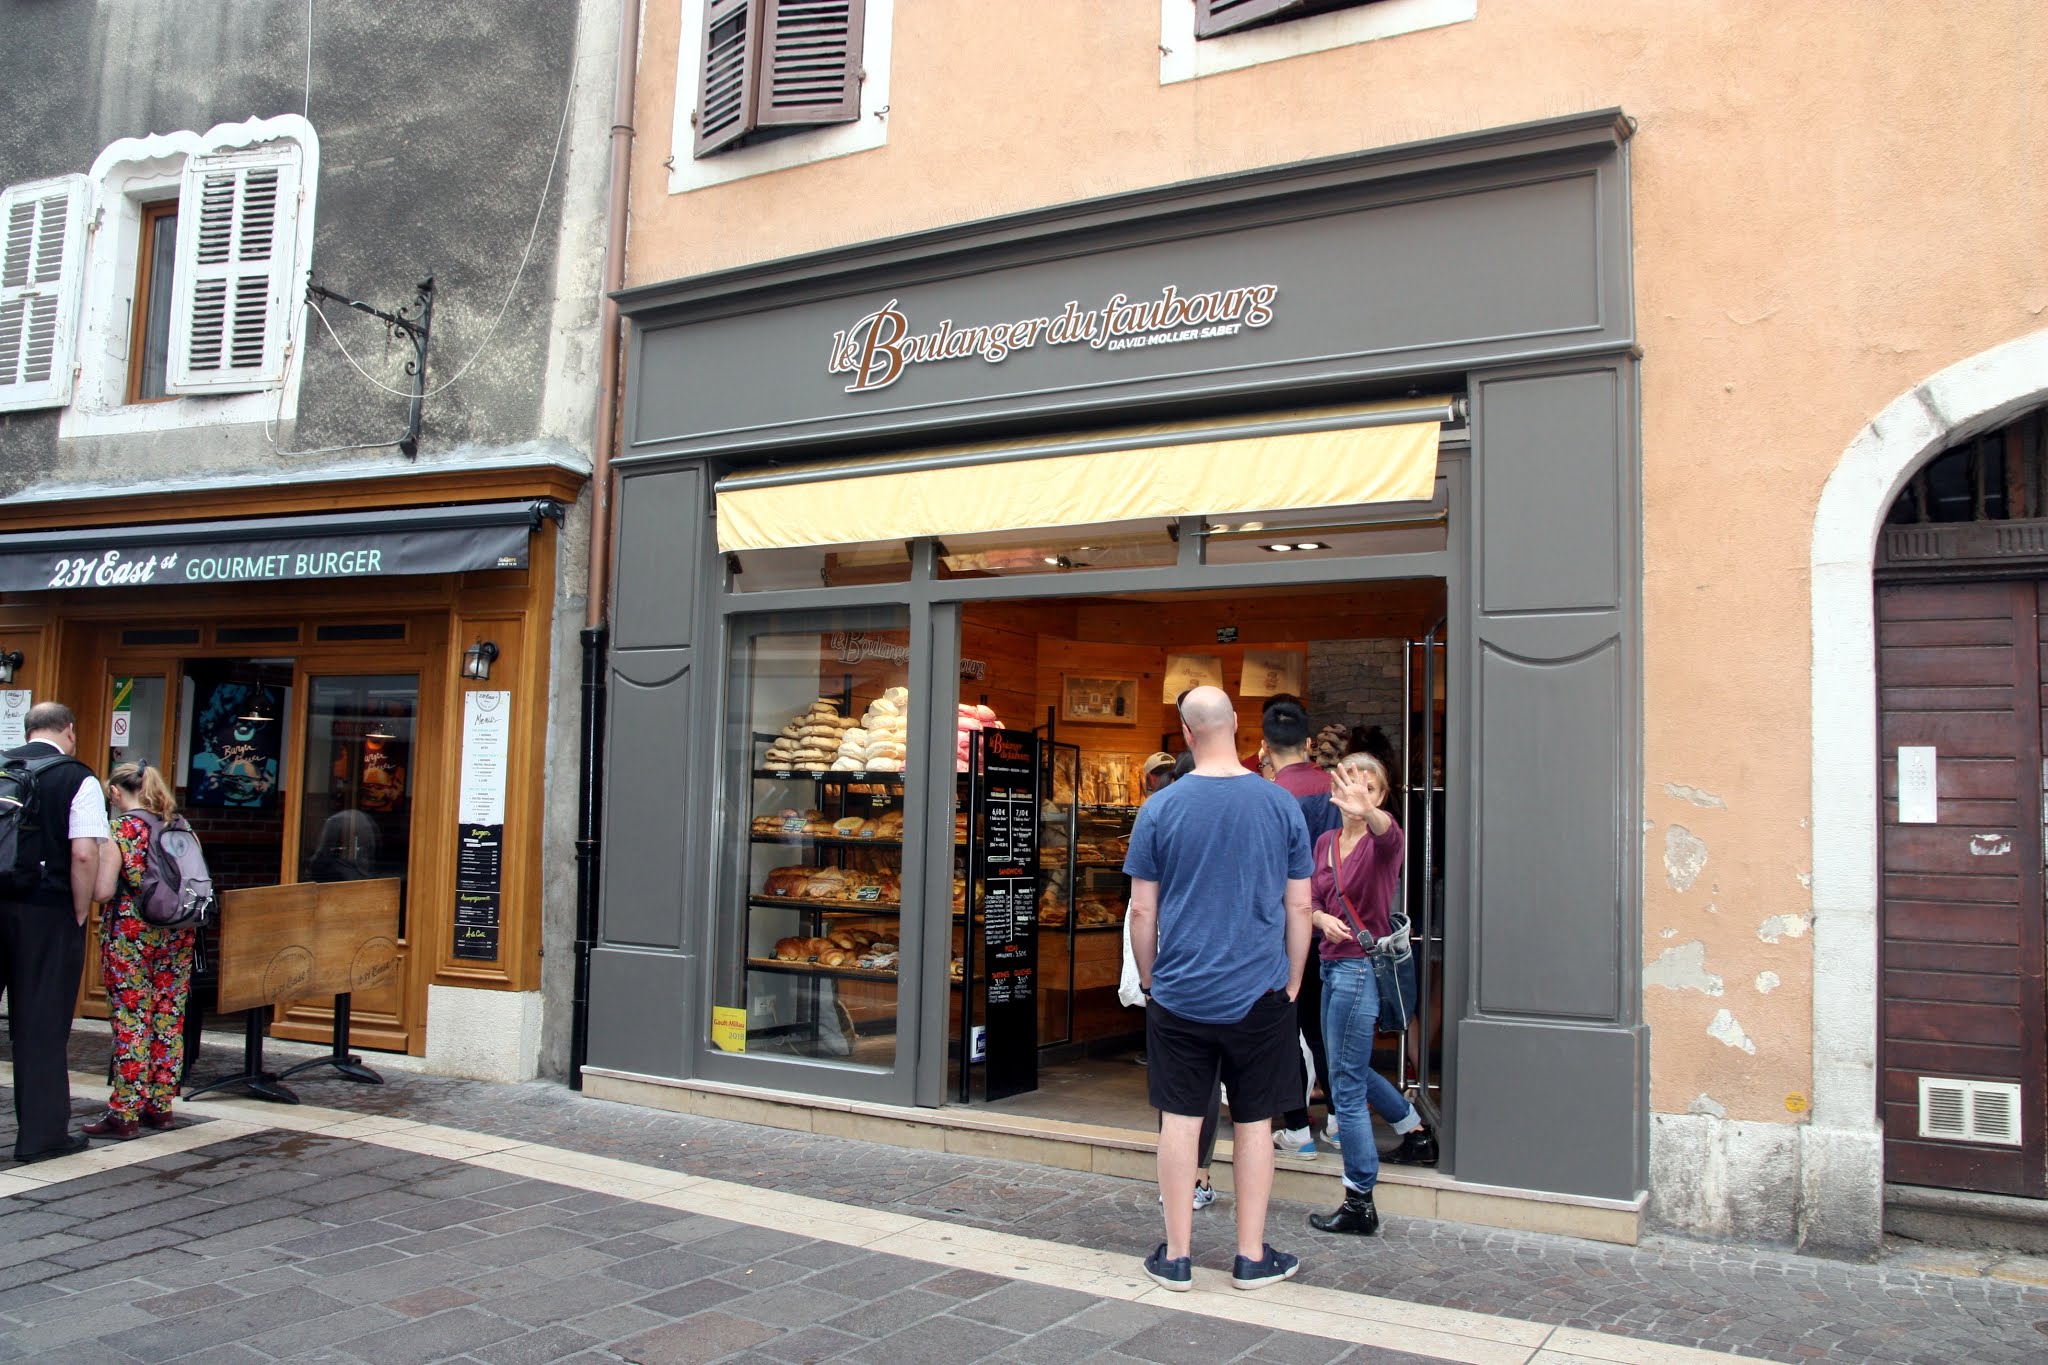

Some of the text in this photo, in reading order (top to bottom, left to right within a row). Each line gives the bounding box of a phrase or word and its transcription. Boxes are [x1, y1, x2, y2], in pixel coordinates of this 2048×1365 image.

[828, 284, 1278, 393] le Boulanger du faubourg
[1107, 336, 1147, 351] DAVID
[1147, 328, 1200, 346] MOLLIER
[49, 557, 101, 588] 231
[98, 549, 158, 587] East
[185, 554, 290, 580] GOURMET
[294, 549, 382, 576] BURGER
[839, 631, 910, 667] Boulange
[728, 1031, 745, 1041] 2018
